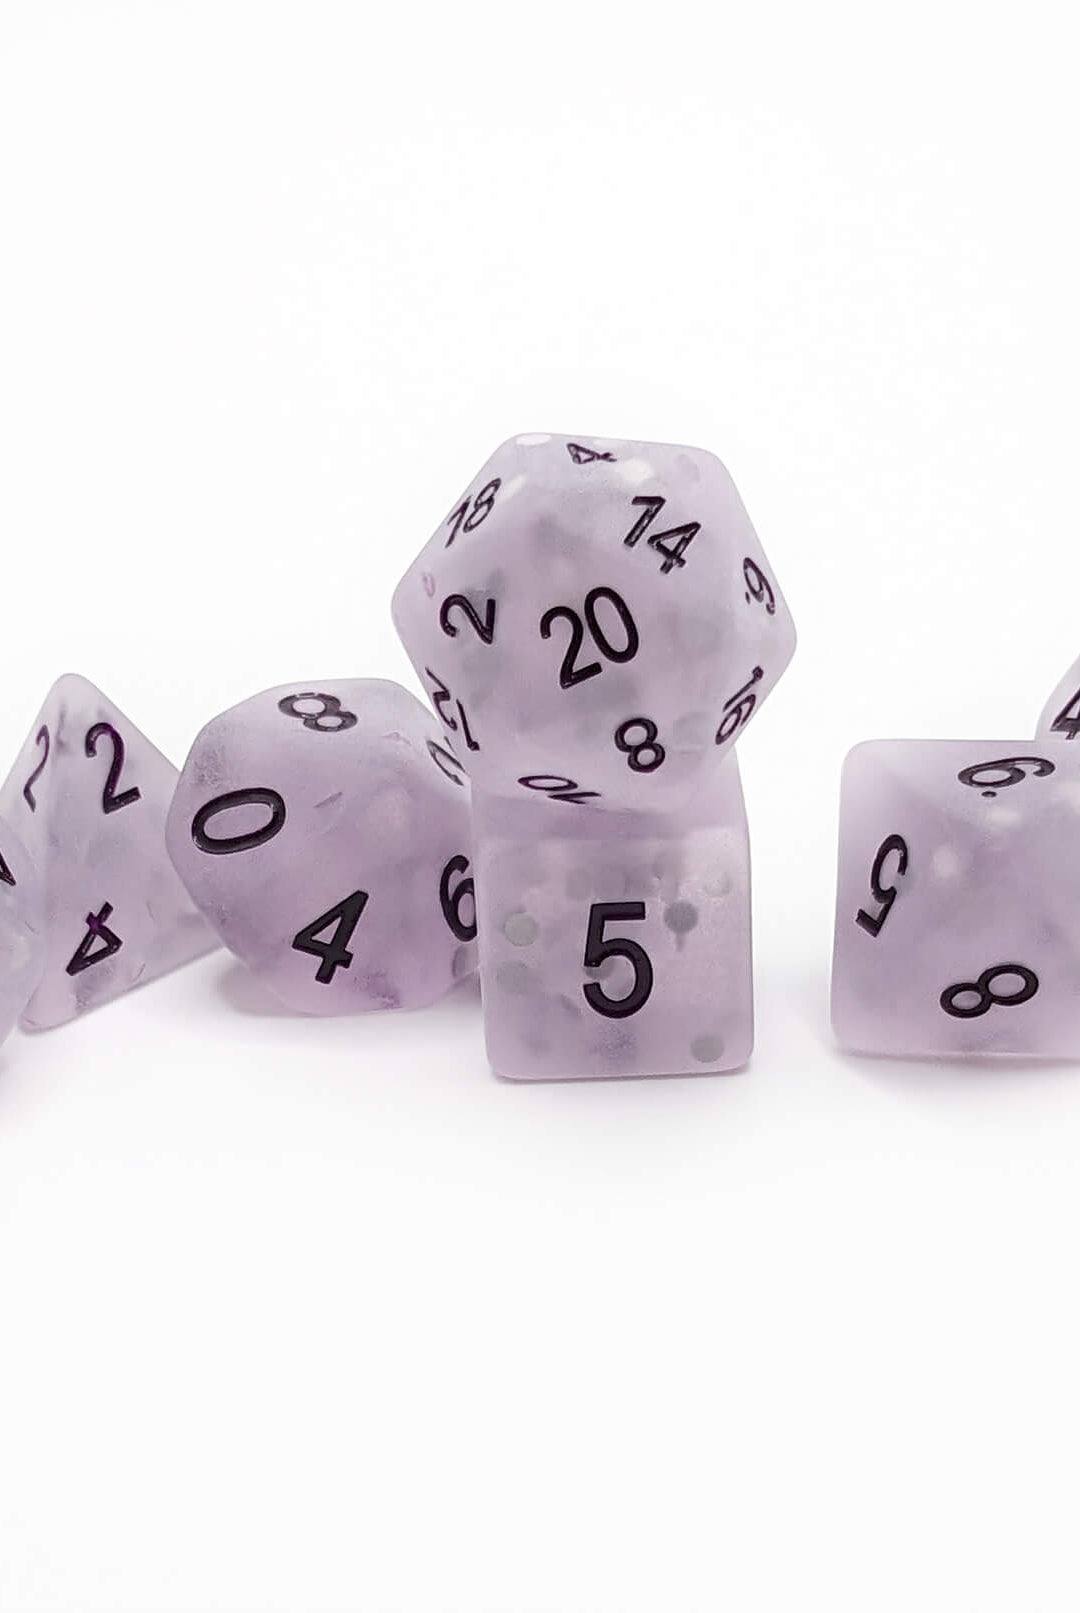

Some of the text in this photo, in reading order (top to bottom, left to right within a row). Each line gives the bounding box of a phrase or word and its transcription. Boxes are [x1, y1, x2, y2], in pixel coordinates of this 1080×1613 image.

[566, 442, 617, 464] 4
[445, 477, 501, 548] 18
[623, 495, 701, 574] 14
[439, 593, 496, 645] 2
[539, 586, 640, 690] 20
[278, 688, 358, 732] 8
[614, 717, 666, 773] 8
[84, 722, 142, 815] 2
[191, 786, 287, 856] 0
[855, 834, 909, 939] 5
[65, 901, 123, 977] 4
[291, 889, 370, 985] 4
[582, 901, 654, 1020] 5
[939, 963, 1040, 1019] 8
